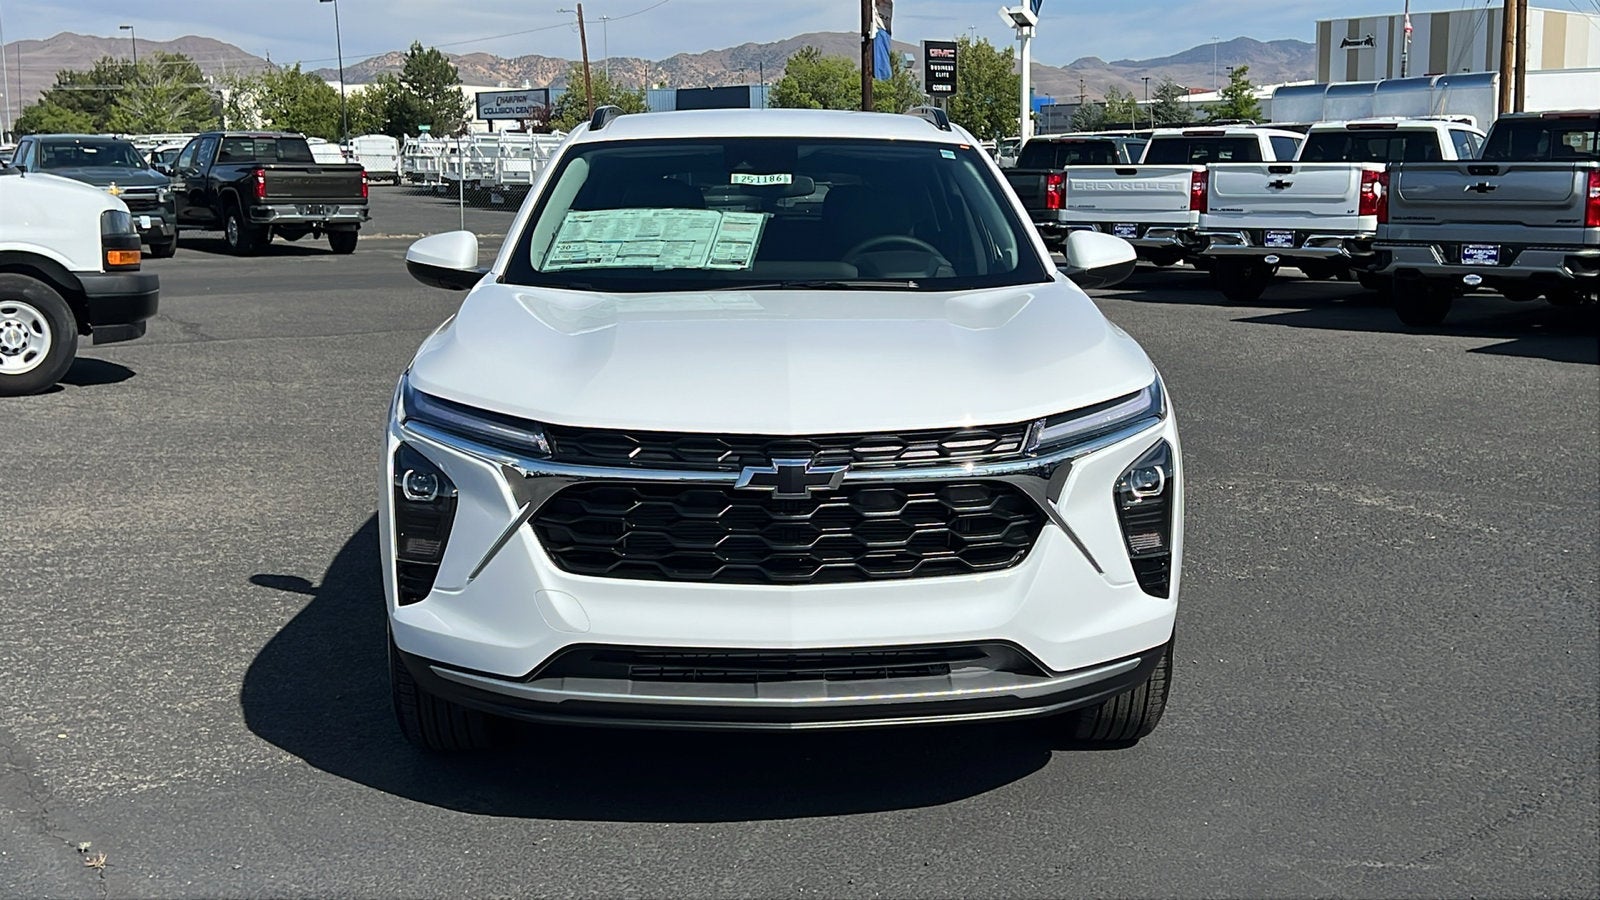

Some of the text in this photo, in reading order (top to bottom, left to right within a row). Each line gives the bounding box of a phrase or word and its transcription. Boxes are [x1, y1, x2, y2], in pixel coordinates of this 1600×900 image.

[930, 49, 955, 57] GMC
[483, 107, 515, 115] COLLISION
[1072, 181, 1181, 191] CHEVROLET
